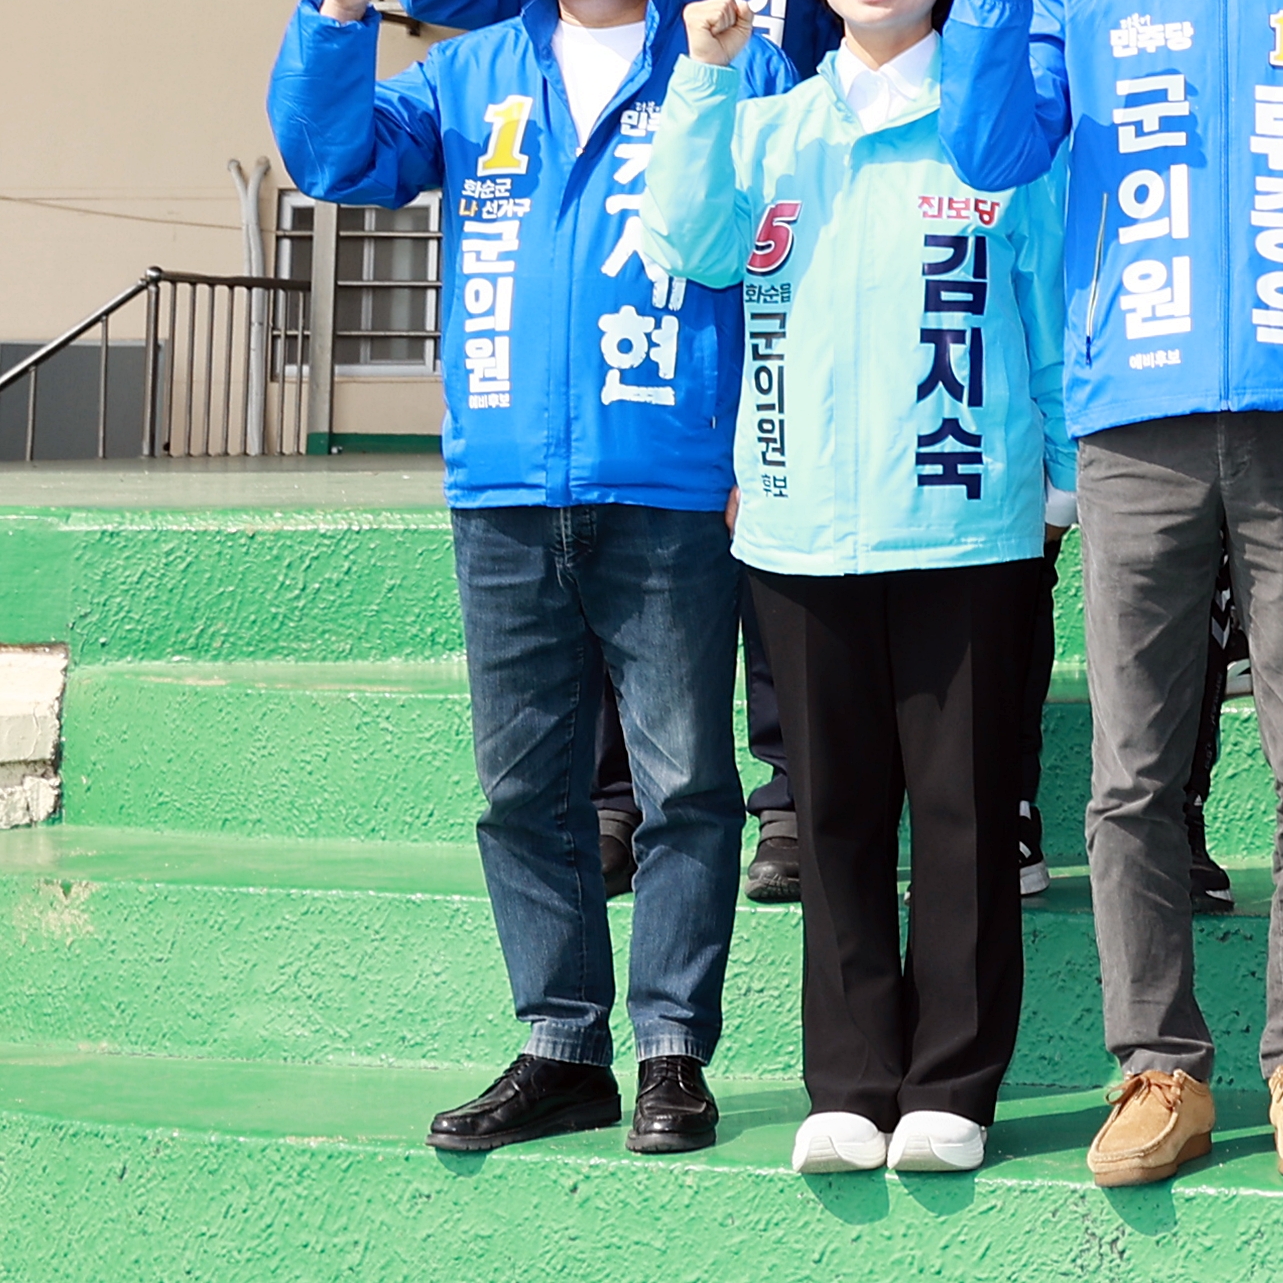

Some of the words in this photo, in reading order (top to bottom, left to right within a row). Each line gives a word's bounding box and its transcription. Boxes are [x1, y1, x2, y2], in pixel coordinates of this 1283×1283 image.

[1109, 20, 1195, 58] 민주당
[476, 94, 534, 178] 1
[459, 197, 479, 217] 나
[481, 197, 531, 220] 선거구
[461, 177, 512, 200] 화순군
[917, 195, 1001, 227] 진보당
[1111, 72, 1192, 341] 군의원
[746, 200, 803, 277] 5
[461, 219, 521, 394] 군의원
[744, 282, 792, 304] 화순읍
[749, 311, 788, 468] 군의원
[914, 233, 989, 501] 김지숙
[762, 472, 789, 499] 후보
